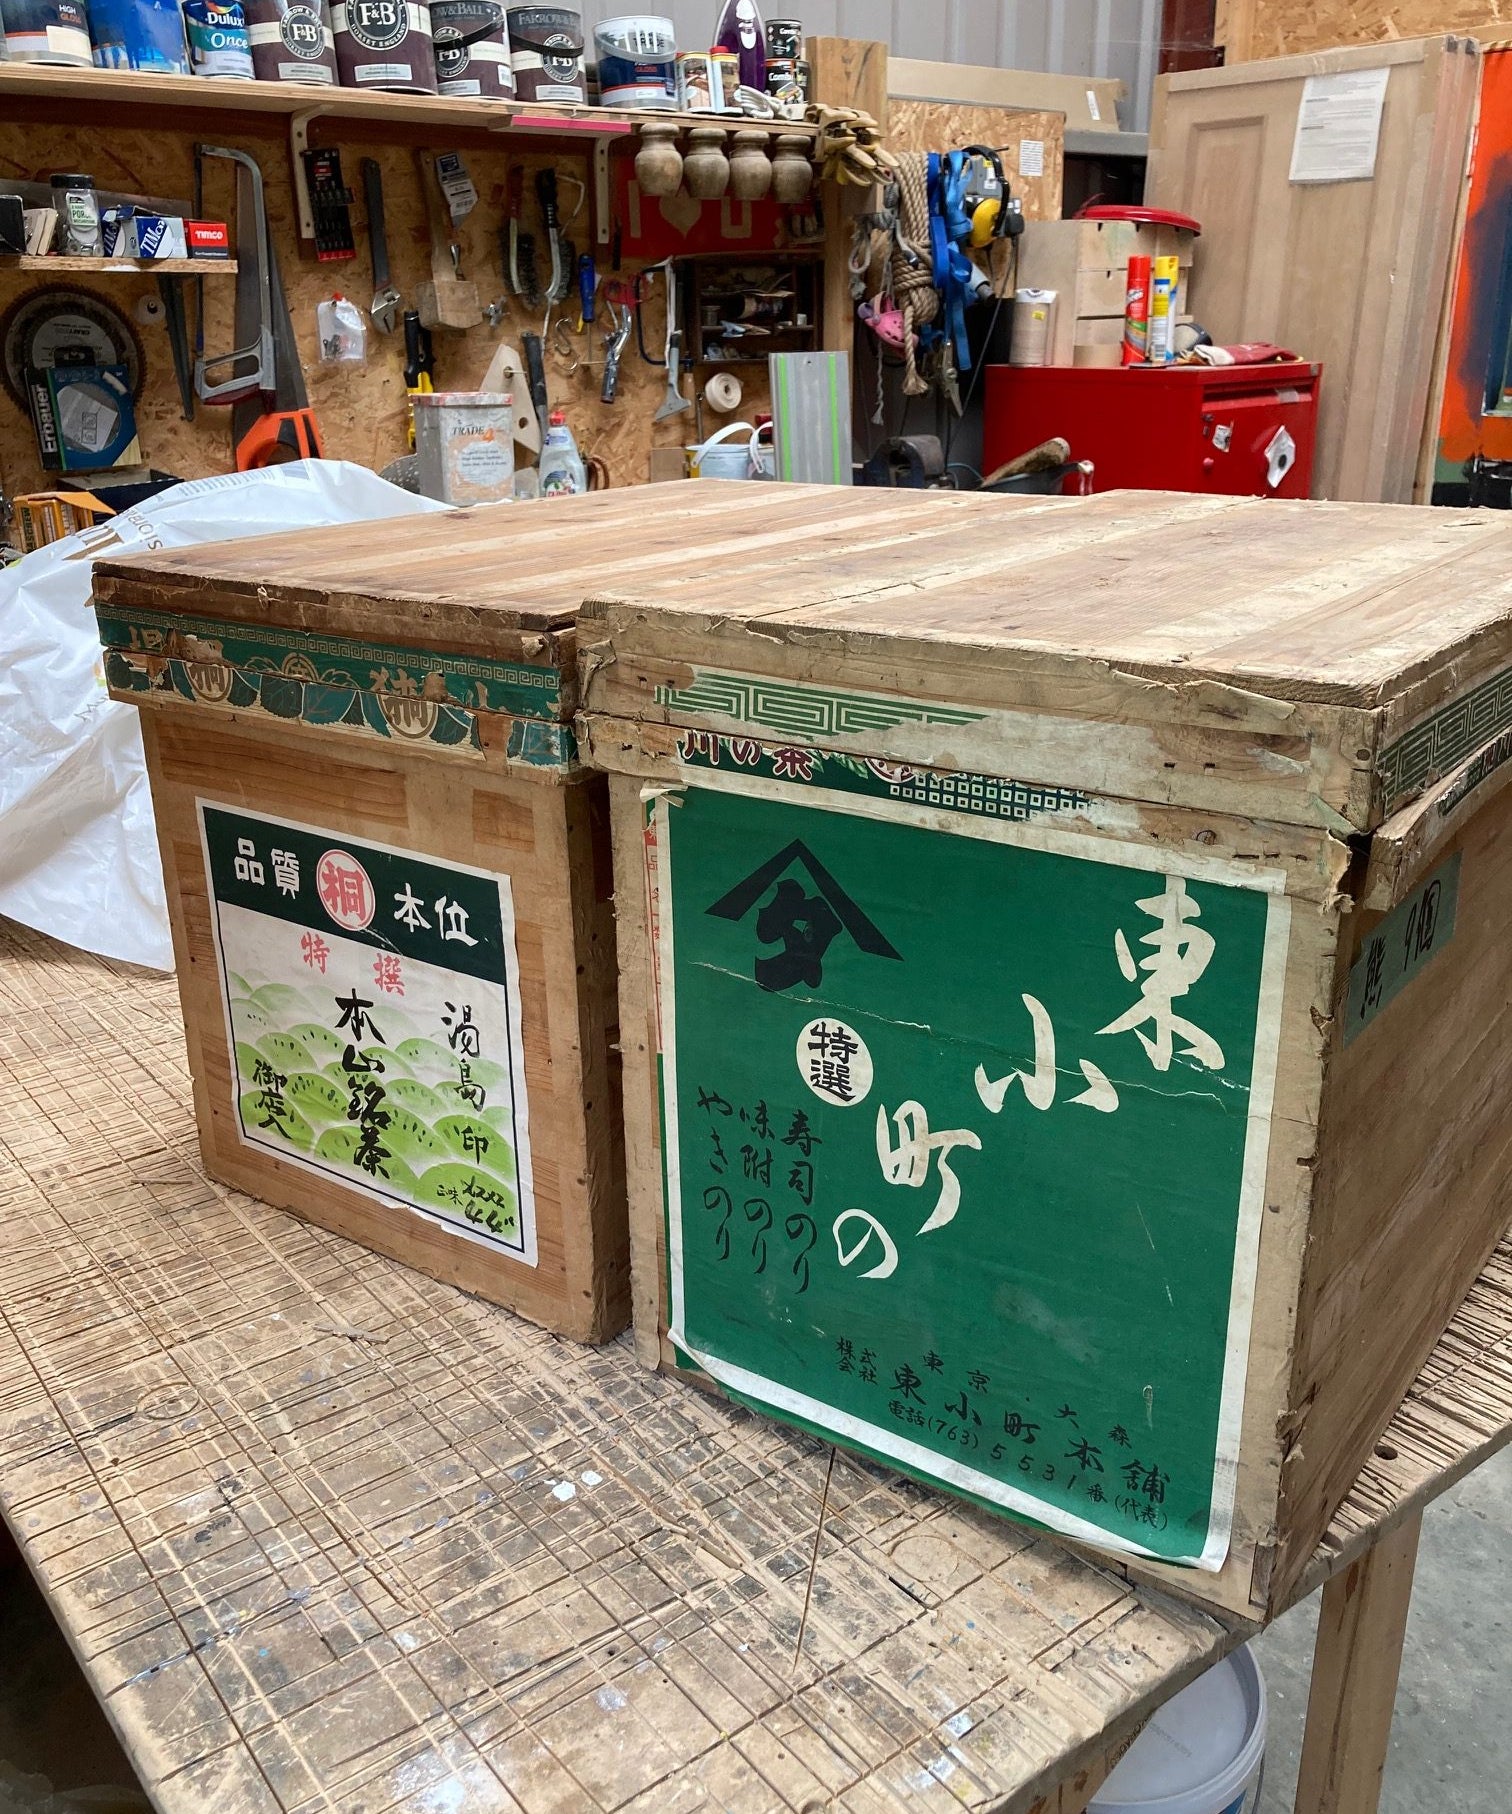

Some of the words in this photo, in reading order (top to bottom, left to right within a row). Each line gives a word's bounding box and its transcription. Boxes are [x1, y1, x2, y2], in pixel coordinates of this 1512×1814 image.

[59, 4, 77, 14] HIGH
[207, 12, 244, 27] Dulux
[359, 2, 397, 26] F&B
[210, 33, 249, 49] Once
[290, 23, 317, 42] F&B
[33, 384, 57, 453] Erbauer
[234, 837, 300, 899] 品質
[394, 882, 479, 946] 本位
[807, 1021, 859, 1102] 特選
[697, 1086, 734, 1261] やきのり
[781, 1108, 823, 1295] 寿司のり
